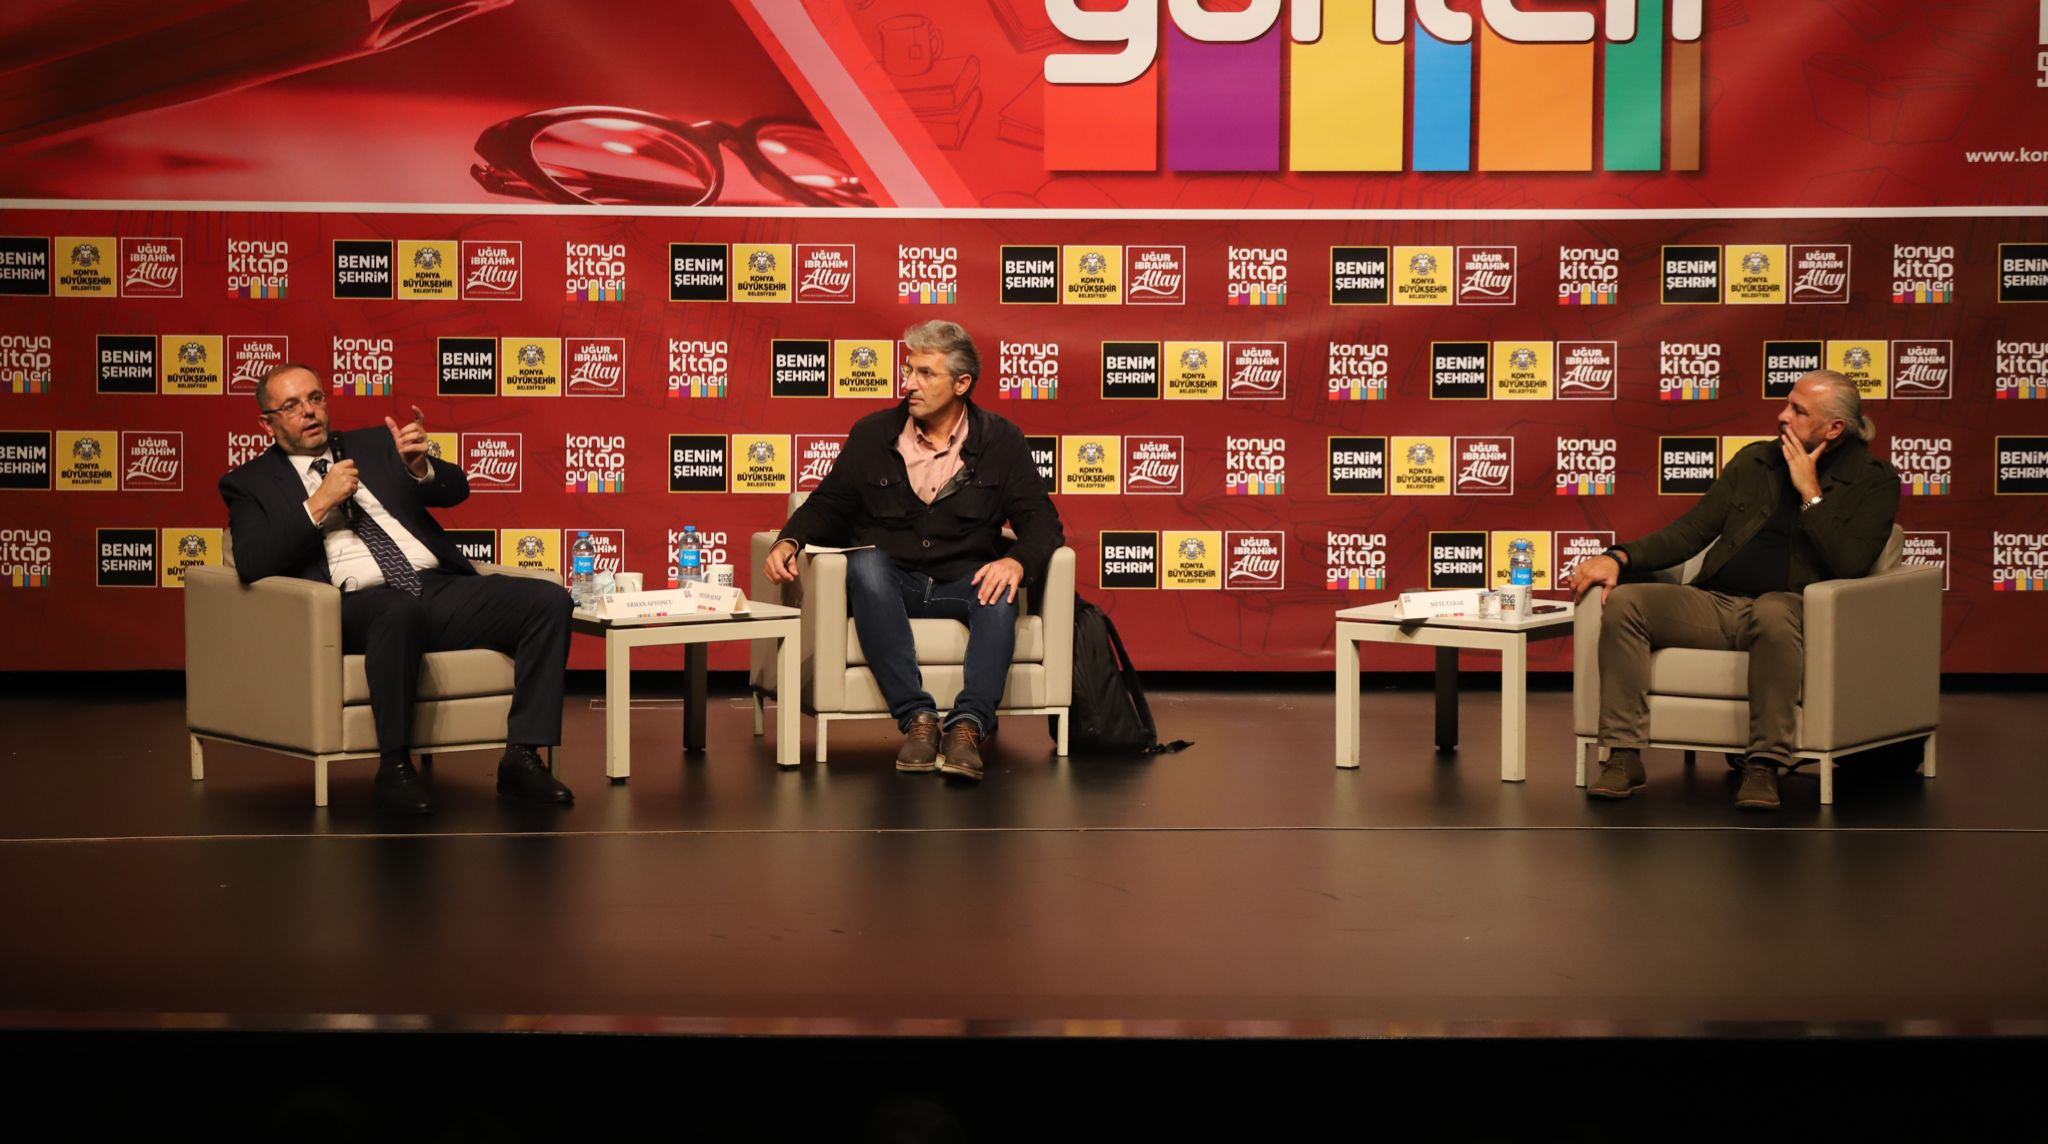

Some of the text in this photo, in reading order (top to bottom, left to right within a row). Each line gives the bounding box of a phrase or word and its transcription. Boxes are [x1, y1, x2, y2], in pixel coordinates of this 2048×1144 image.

[137, 242, 168, 253] UĞUR
[227, 238, 289, 257] konya
[478, 246, 508, 257] UĞUR
[566, 242, 625, 261] konya
[811, 249, 841, 260] UĞUR
[898, 244, 957, 264] konya
[1141, 251, 1171, 262] UĞUR
[1228, 246, 1287, 265] konya
[1472, 252, 1502, 262] UĞUR
[1559, 246, 1618, 265] konya
[1805, 250, 1835, 260] UĞUR
[1893, 243, 1954, 262] konya
[125, 261, 179, 288] Altay
[227, 253, 288, 277] kitap
[566, 257, 625, 279] kitap
[898, 260, 957, 282] kitap
[1228, 261, 1287, 283] kitap
[1559, 261, 1618, 283] kitap
[1893, 258, 1954, 281] kitap
[227, 274, 288, 291] günleri
[465, 265, 519, 291] Altay
[566, 276, 625, 293] günleri
[799, 267, 852, 293] Altay
[898, 279, 957, 296] günleri
[1129, 269, 1182, 295] Altay
[1460, 270, 1512, 296] Altay
[1793, 268, 1846, 294] Altay
[1893, 278, 1954, 296] günleri
[1228, 280, 1287, 297] günleri
[1559, 280, 1618, 297] günleri
[333, 336, 393, 355] konya
[580, 343, 610, 354] UĞUR
[669, 338, 728, 357] konya
[1000, 340, 1058, 359] konya
[1242, 347, 1272, 357] UĞUR
[1329, 341, 1388, 360] konya
[1572, 346, 1602, 357] UĞUR
[1660, 341, 1720, 360] konya
[1907, 345, 1937, 356] UĞUR
[333, 351, 393, 374] kitap
[669, 354, 727, 376] kitap
[1000, 355, 1058, 377] kitap
[1329, 357, 1387, 379] kitap
[1660, 356, 1720, 379] kitap
[333, 371, 393, 388] günleri
[568, 362, 621, 388] Altay
[669, 373, 727, 390] günleri
[1000, 375, 1058, 391] günleri
[1230, 365, 1282, 391] Altay
[1329, 376, 1387, 393] günleri
[1560, 365, 1613, 391] Altay
[1660, 376, 1720, 393] günleri
[1895, 364, 1948, 390] Altay
[138, 436, 168, 447] UĞUR
[565, 433, 626, 452] konya
[810, 440, 840, 450] UĞUR
[1139, 441, 1169, 452] UĞUR
[1226, 436, 1285, 455] konya
[1469, 442, 1499, 452] UĞUR
[1557, 436, 1616, 455] konya
[1891, 436, 1951, 455] konya
[126, 455, 179, 482] Altay
[565, 448, 625, 471] kitap
[1226, 451, 1285, 473] kitap
[1557, 452, 1615, 474] kitap
[565, 468, 625, 485] günleri
[1127, 459, 1180, 485] Altay
[1226, 470, 1285, 487] günleri
[1457, 460, 1510, 486] Altay
[1557, 471, 1615, 488] günleri
[1240, 536, 1270, 546] UĞUR
[1327, 530, 1386, 550] konya
[1570, 537, 1600, 547] UĞUR
[1905, 537, 1935, 547] UĞUR
[1327, 546, 1386, 568] kitap
[1228, 554, 1280, 580] Altay
[1327, 565, 1386, 582] günleri
